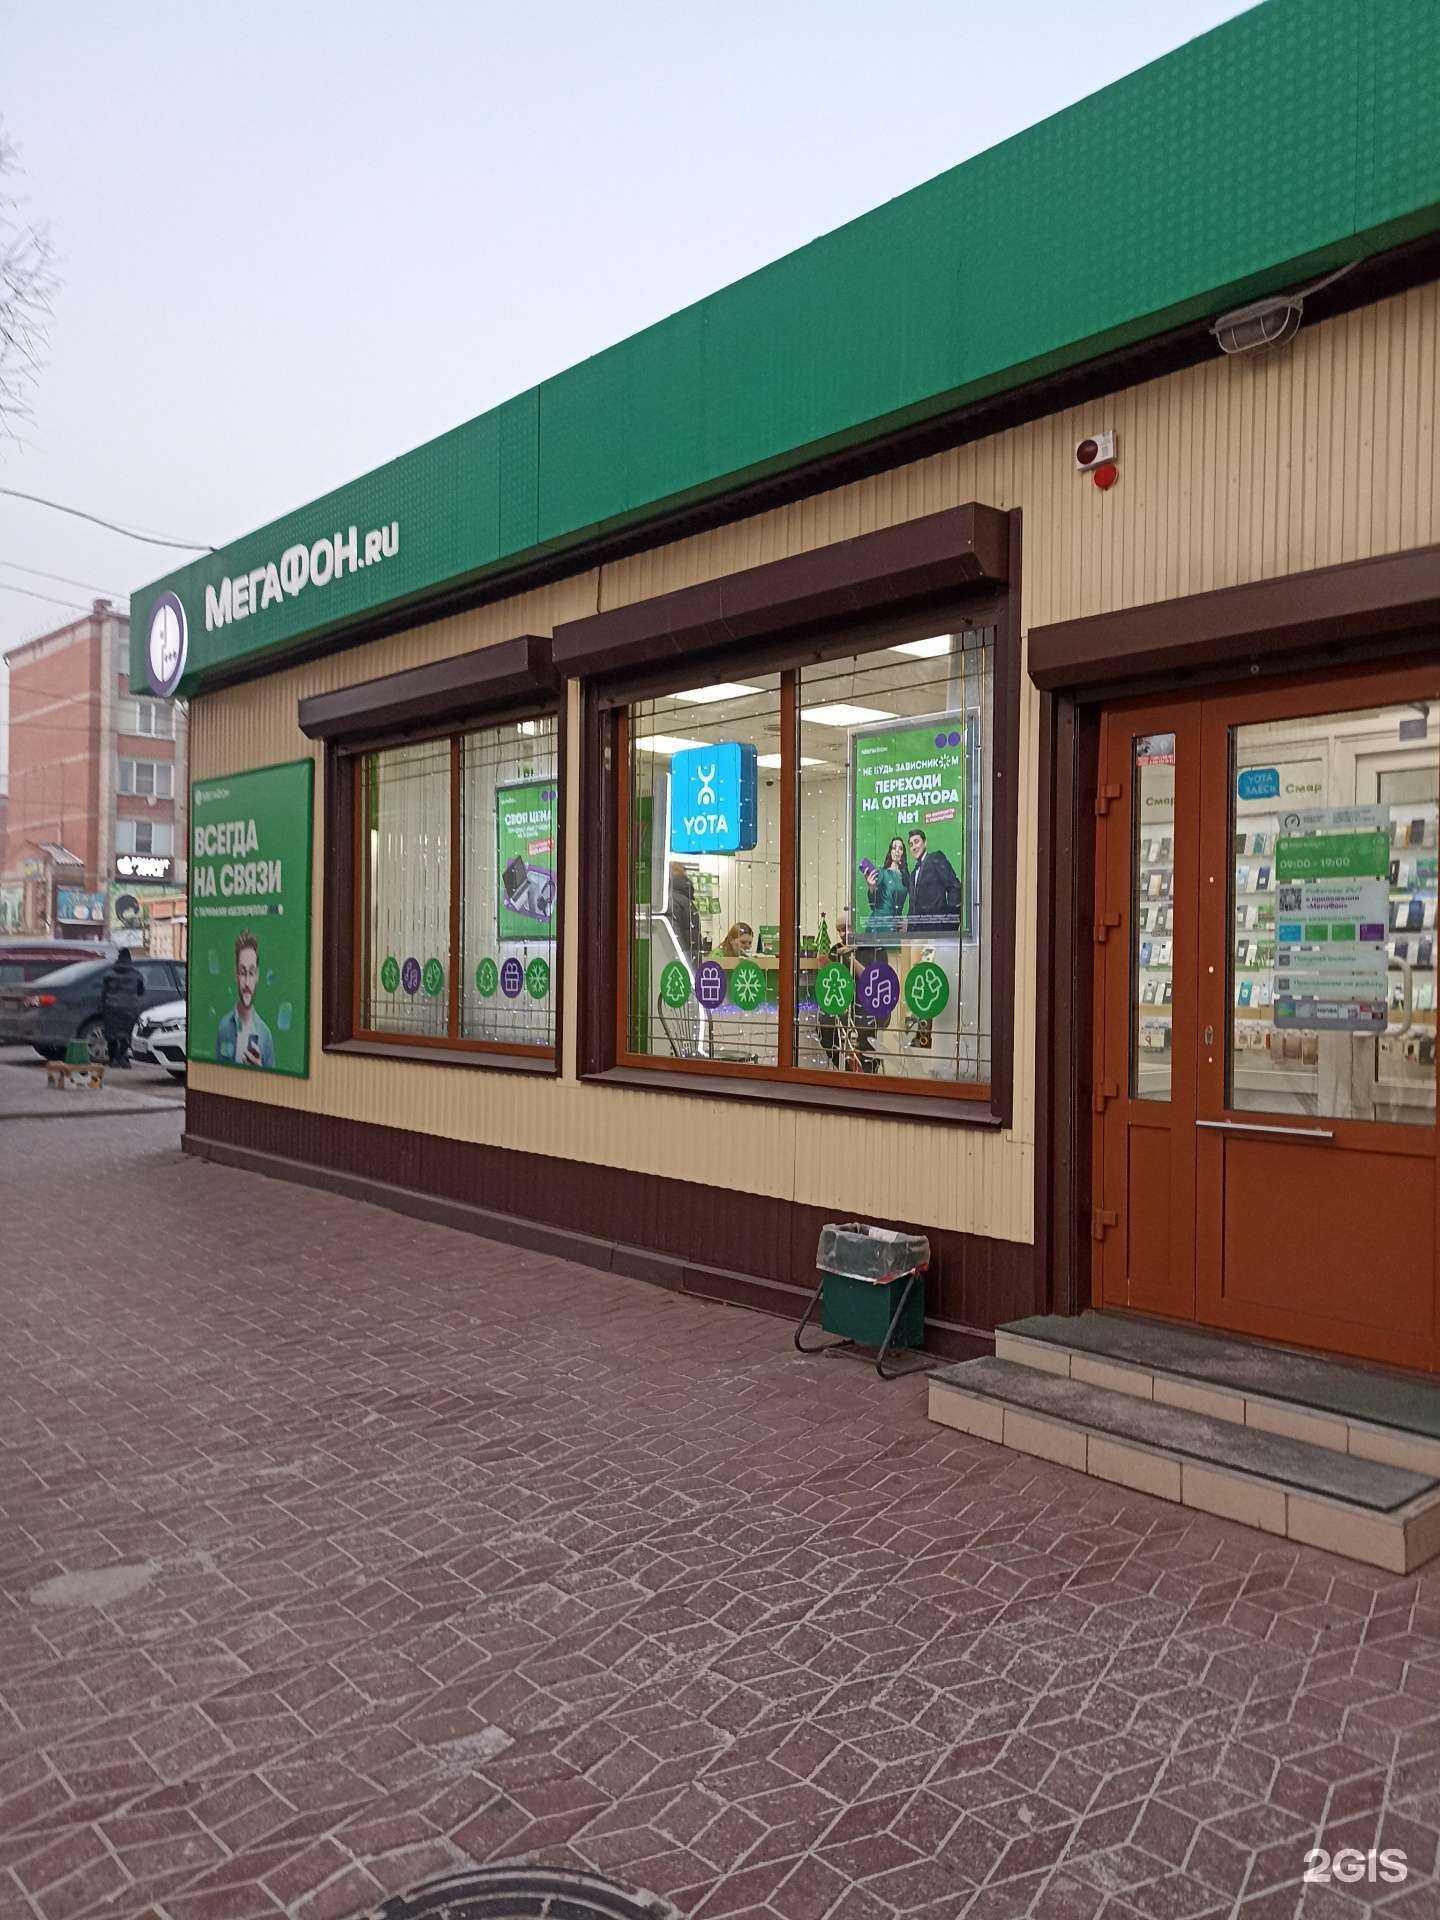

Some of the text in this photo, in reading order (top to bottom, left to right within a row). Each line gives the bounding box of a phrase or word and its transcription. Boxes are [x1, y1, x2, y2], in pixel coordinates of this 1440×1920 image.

[863, 767, 874, 777] НЕ
[875, 764, 894, 776] БУДЬ
[875, 774, 942, 794] ПЕРЕХОДИ
[862, 788, 960, 812] НА ОПЕРАТОРА
[683, 813, 728, 836] YOTA
[897, 810, 919, 824] №1
[194, 818, 259, 859] ВСЕГДА
[194, 865, 217, 898] НА
[220, 859, 282, 898] СВЯЗИ
